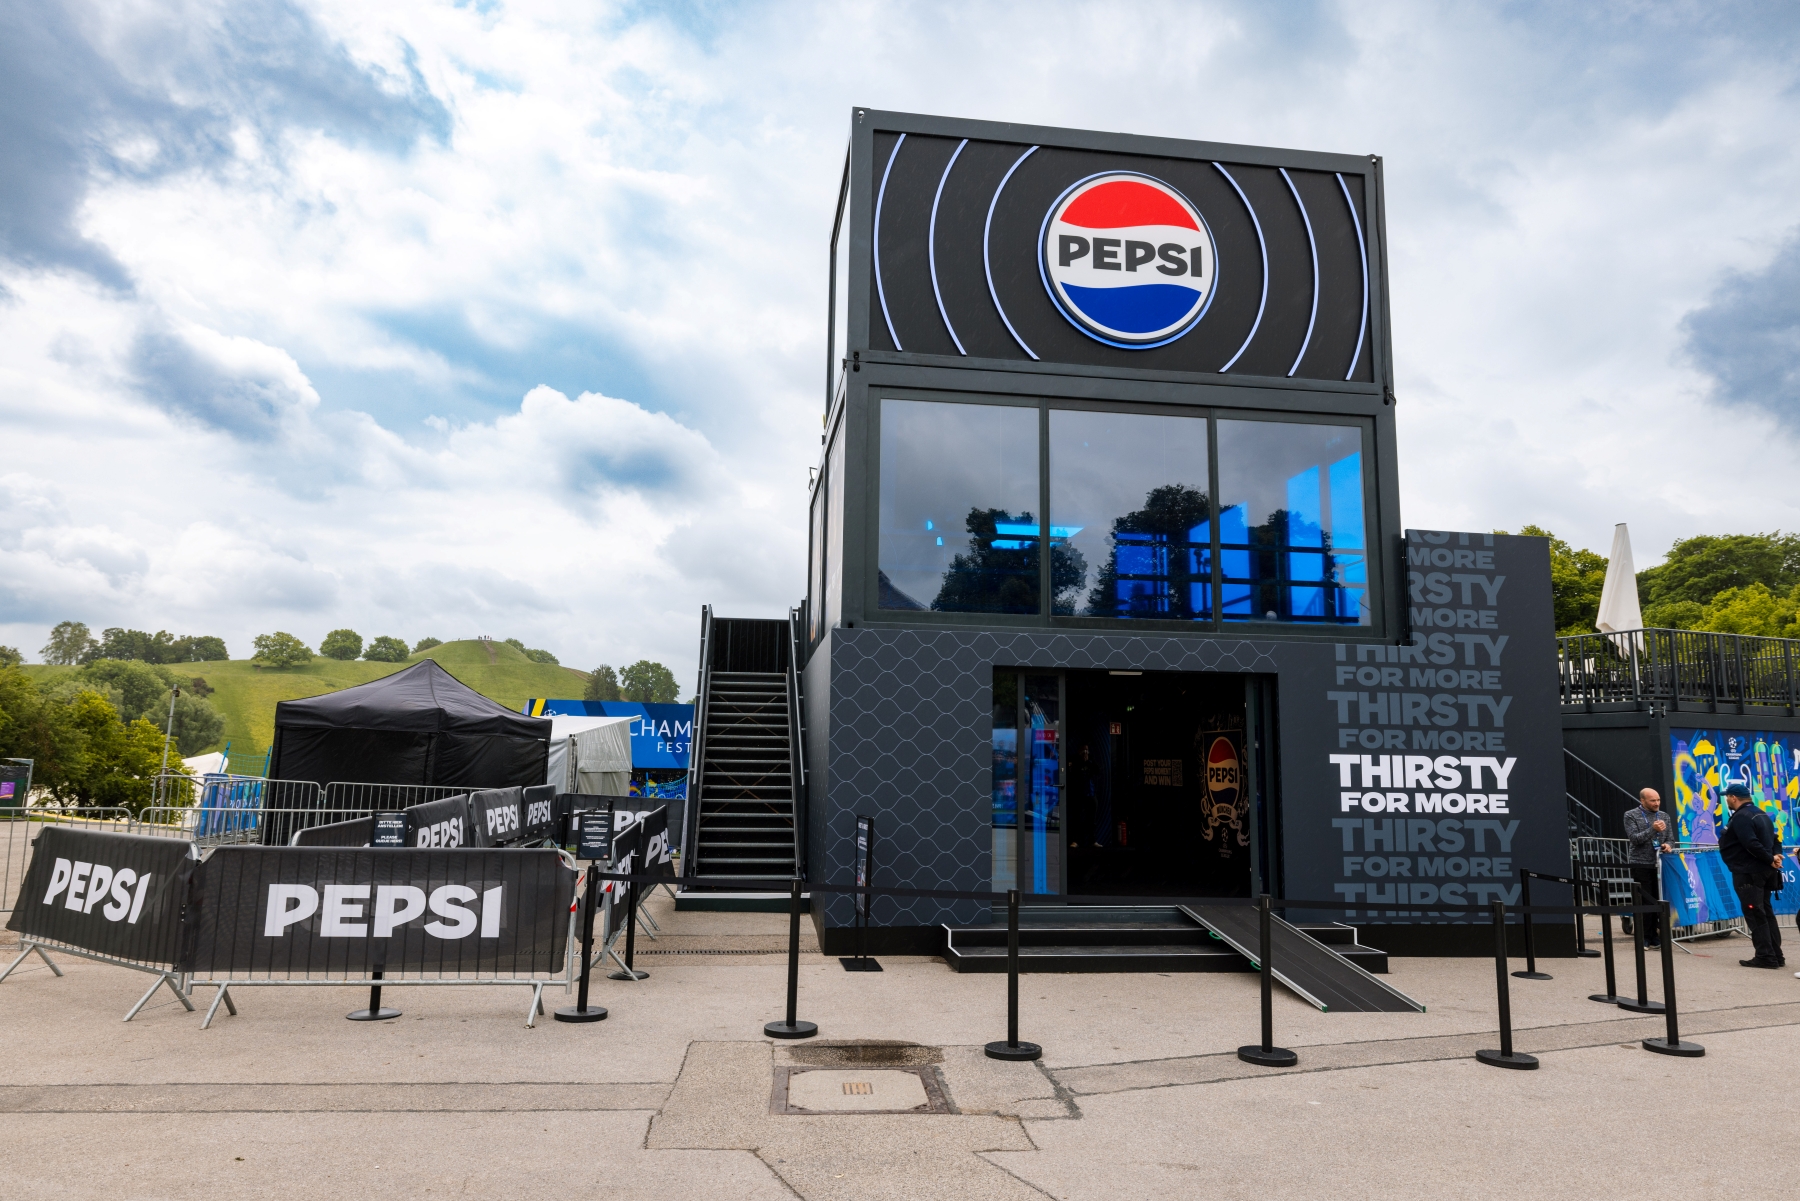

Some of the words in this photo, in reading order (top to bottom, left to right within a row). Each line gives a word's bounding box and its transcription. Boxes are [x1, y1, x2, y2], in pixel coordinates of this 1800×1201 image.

[1059, 234, 1202, 278] PEPSI
[1408, 547, 1495, 570] MORE
[1409, 607, 1499, 629] MORE
[1336, 666, 1404, 687] FOR
[1409, 668, 1502, 690] MORE
[1327, 691, 1513, 728] THIRSTY
[1338, 728, 1407, 750] FOR
[1412, 729, 1506, 751] MORE
[1143, 759, 1157, 767] POST
[1157, 759, 1172, 768] YOUR
[1209, 767, 1238, 784] PEPSI
[1329, 753, 1517, 790] THIRSTY
[1143, 775, 1158, 786] AND
[1158, 775, 1172, 787] WIN
[526, 800, 551, 827] PEPSI
[1340, 791, 1410, 813] FOR
[1415, 792, 1509, 814] MORE
[417, 816, 464, 848] PEPSI
[486, 804, 519, 836] PEPSI
[1331, 818, 1521, 852] THIRSTY
[1343, 856, 1412, 877] FOR
[1418, 856, 1512, 877] MORE
[43, 857, 151, 924] PEPSI
[1334, 883, 1522, 917] THIRSTY
[264, 884, 502, 939] PEPSI
